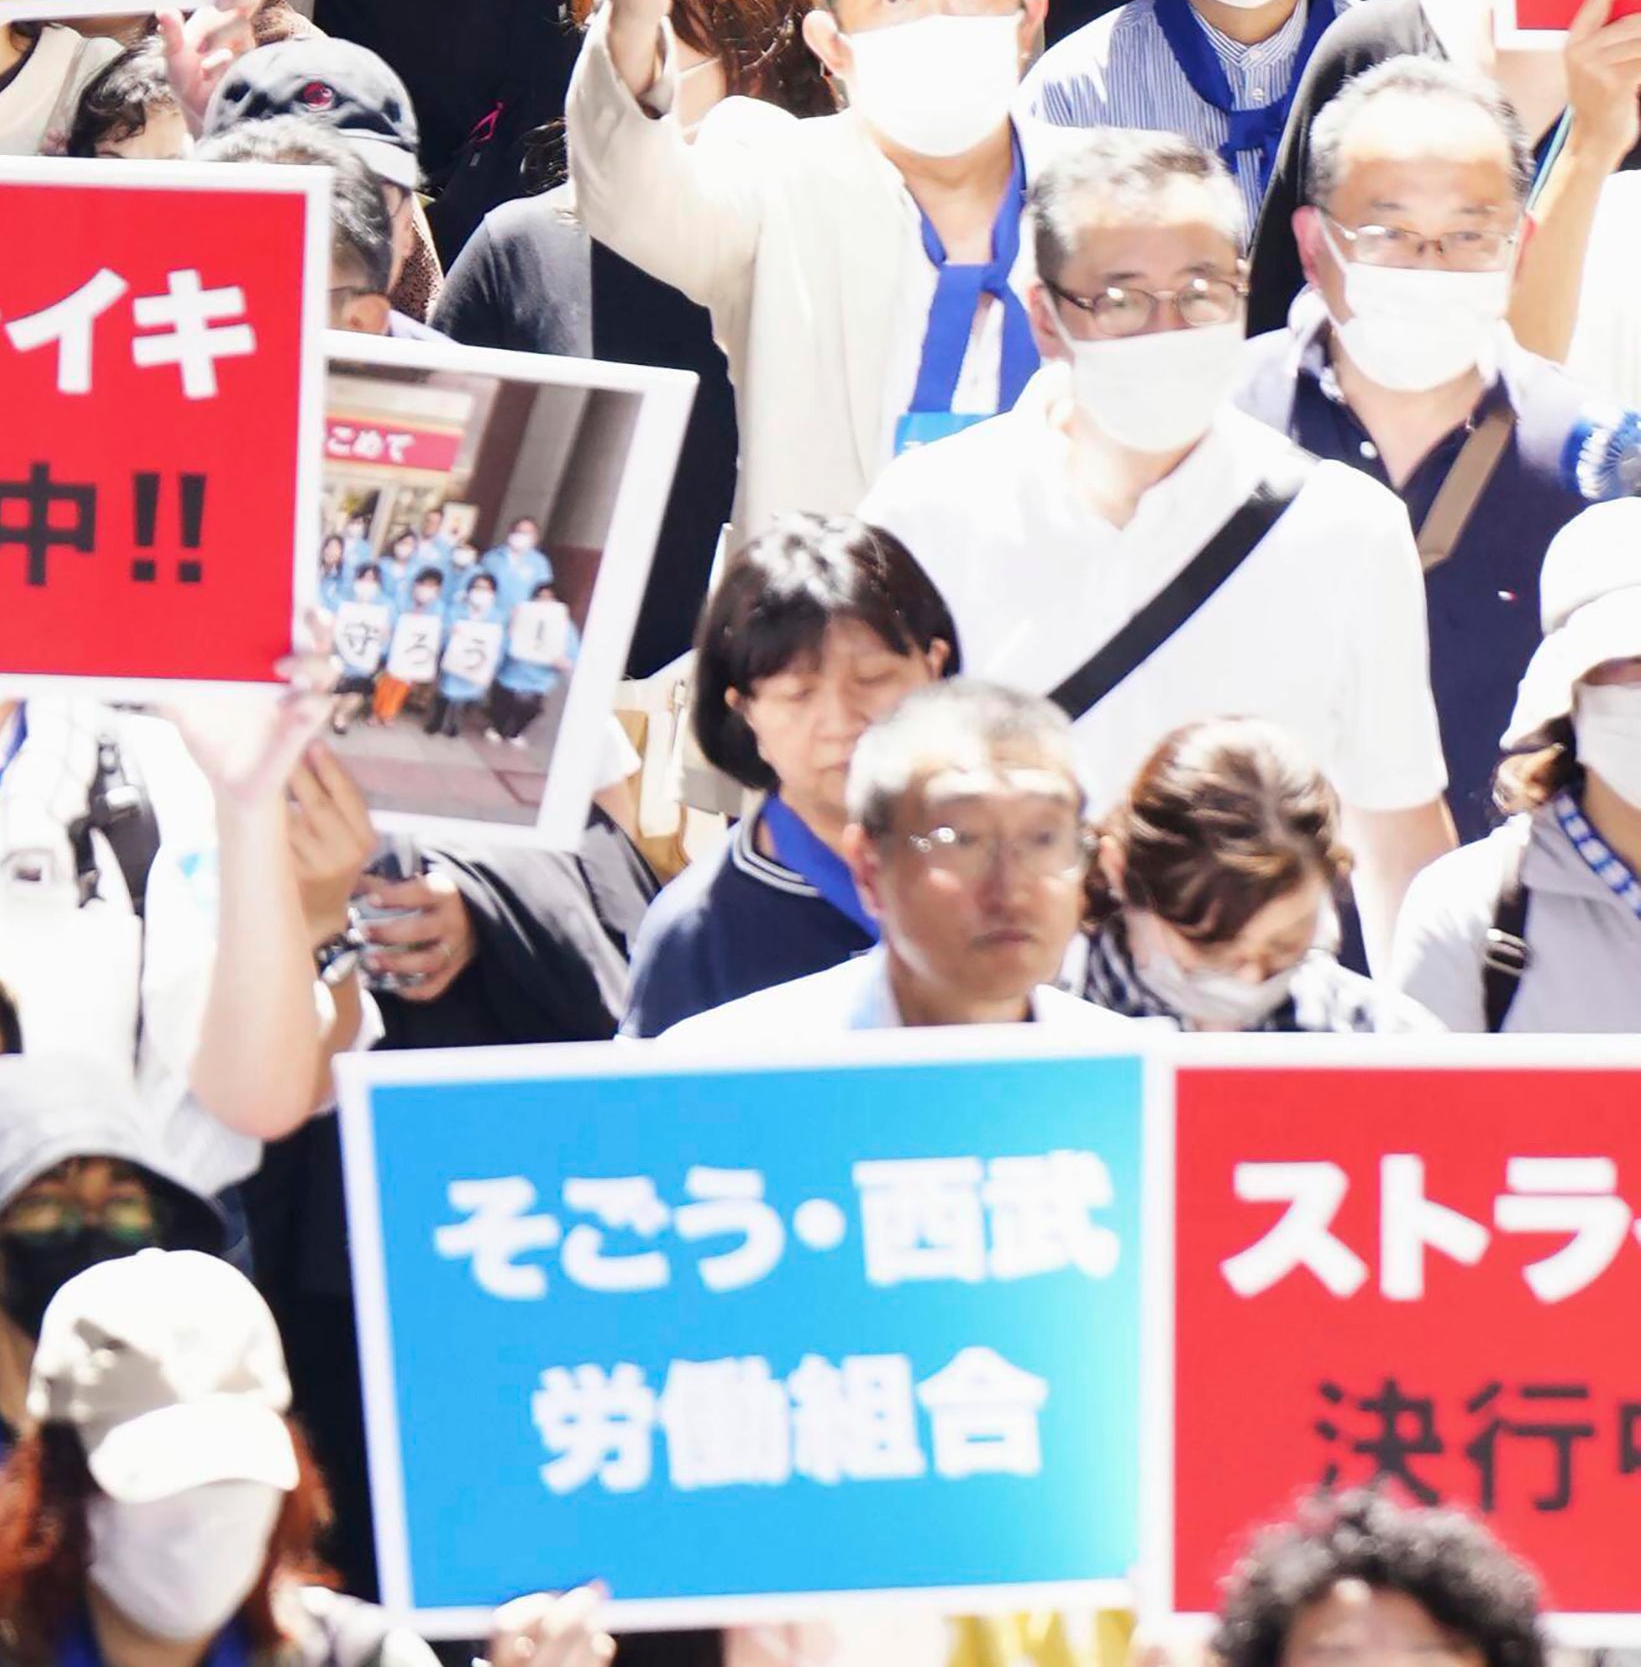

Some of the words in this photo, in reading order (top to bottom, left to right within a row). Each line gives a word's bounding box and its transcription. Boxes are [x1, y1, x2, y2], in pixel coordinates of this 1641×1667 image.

[433, 1149, 1121, 1303] そごう・西武
[1220, 1153, 1641, 1303] ストラ
[528, 1345, 1048, 1497] 労働組合
[1315, 1375, 1641, 1513] 決行
